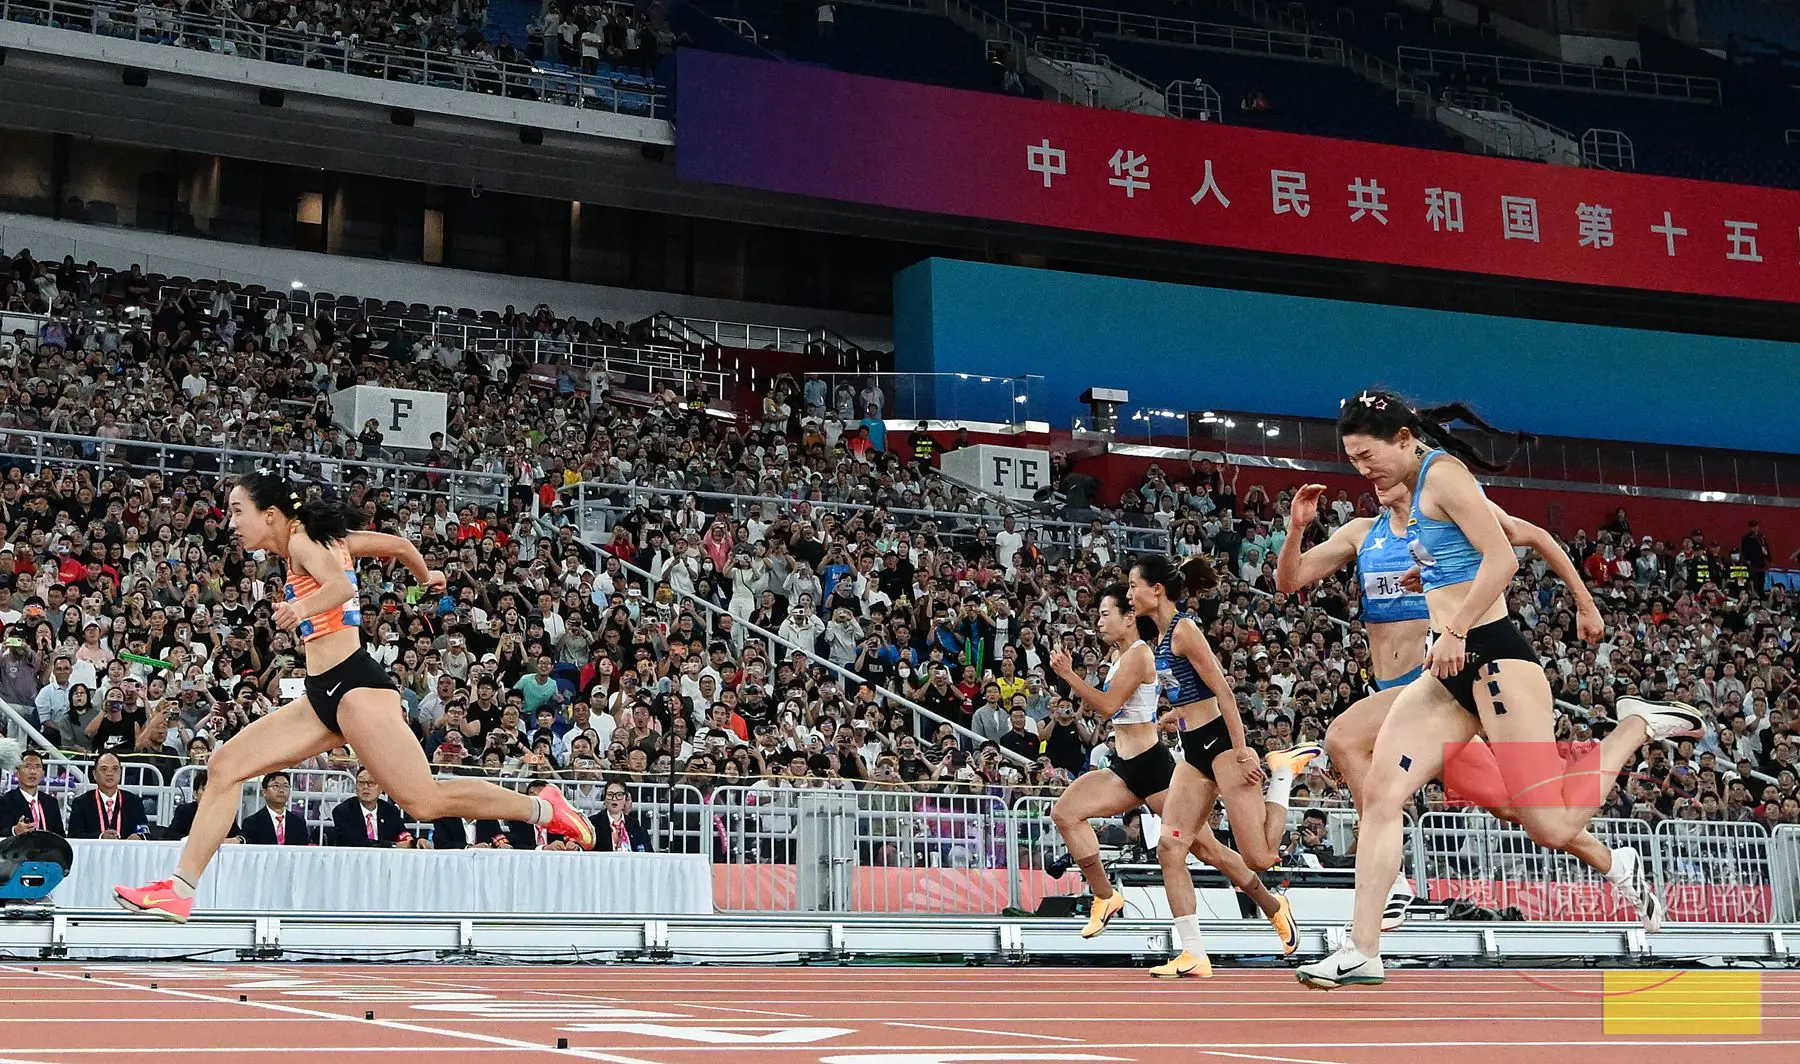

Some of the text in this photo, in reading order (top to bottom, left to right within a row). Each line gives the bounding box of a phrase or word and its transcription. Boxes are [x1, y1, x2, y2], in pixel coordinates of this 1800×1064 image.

[1026, 138, 1800, 264] 中华人民共和国第十五
[389, 398, 413, 431] F
[408, 1003, 695, 1018] 5
[554, 1023, 859, 1044] 4
